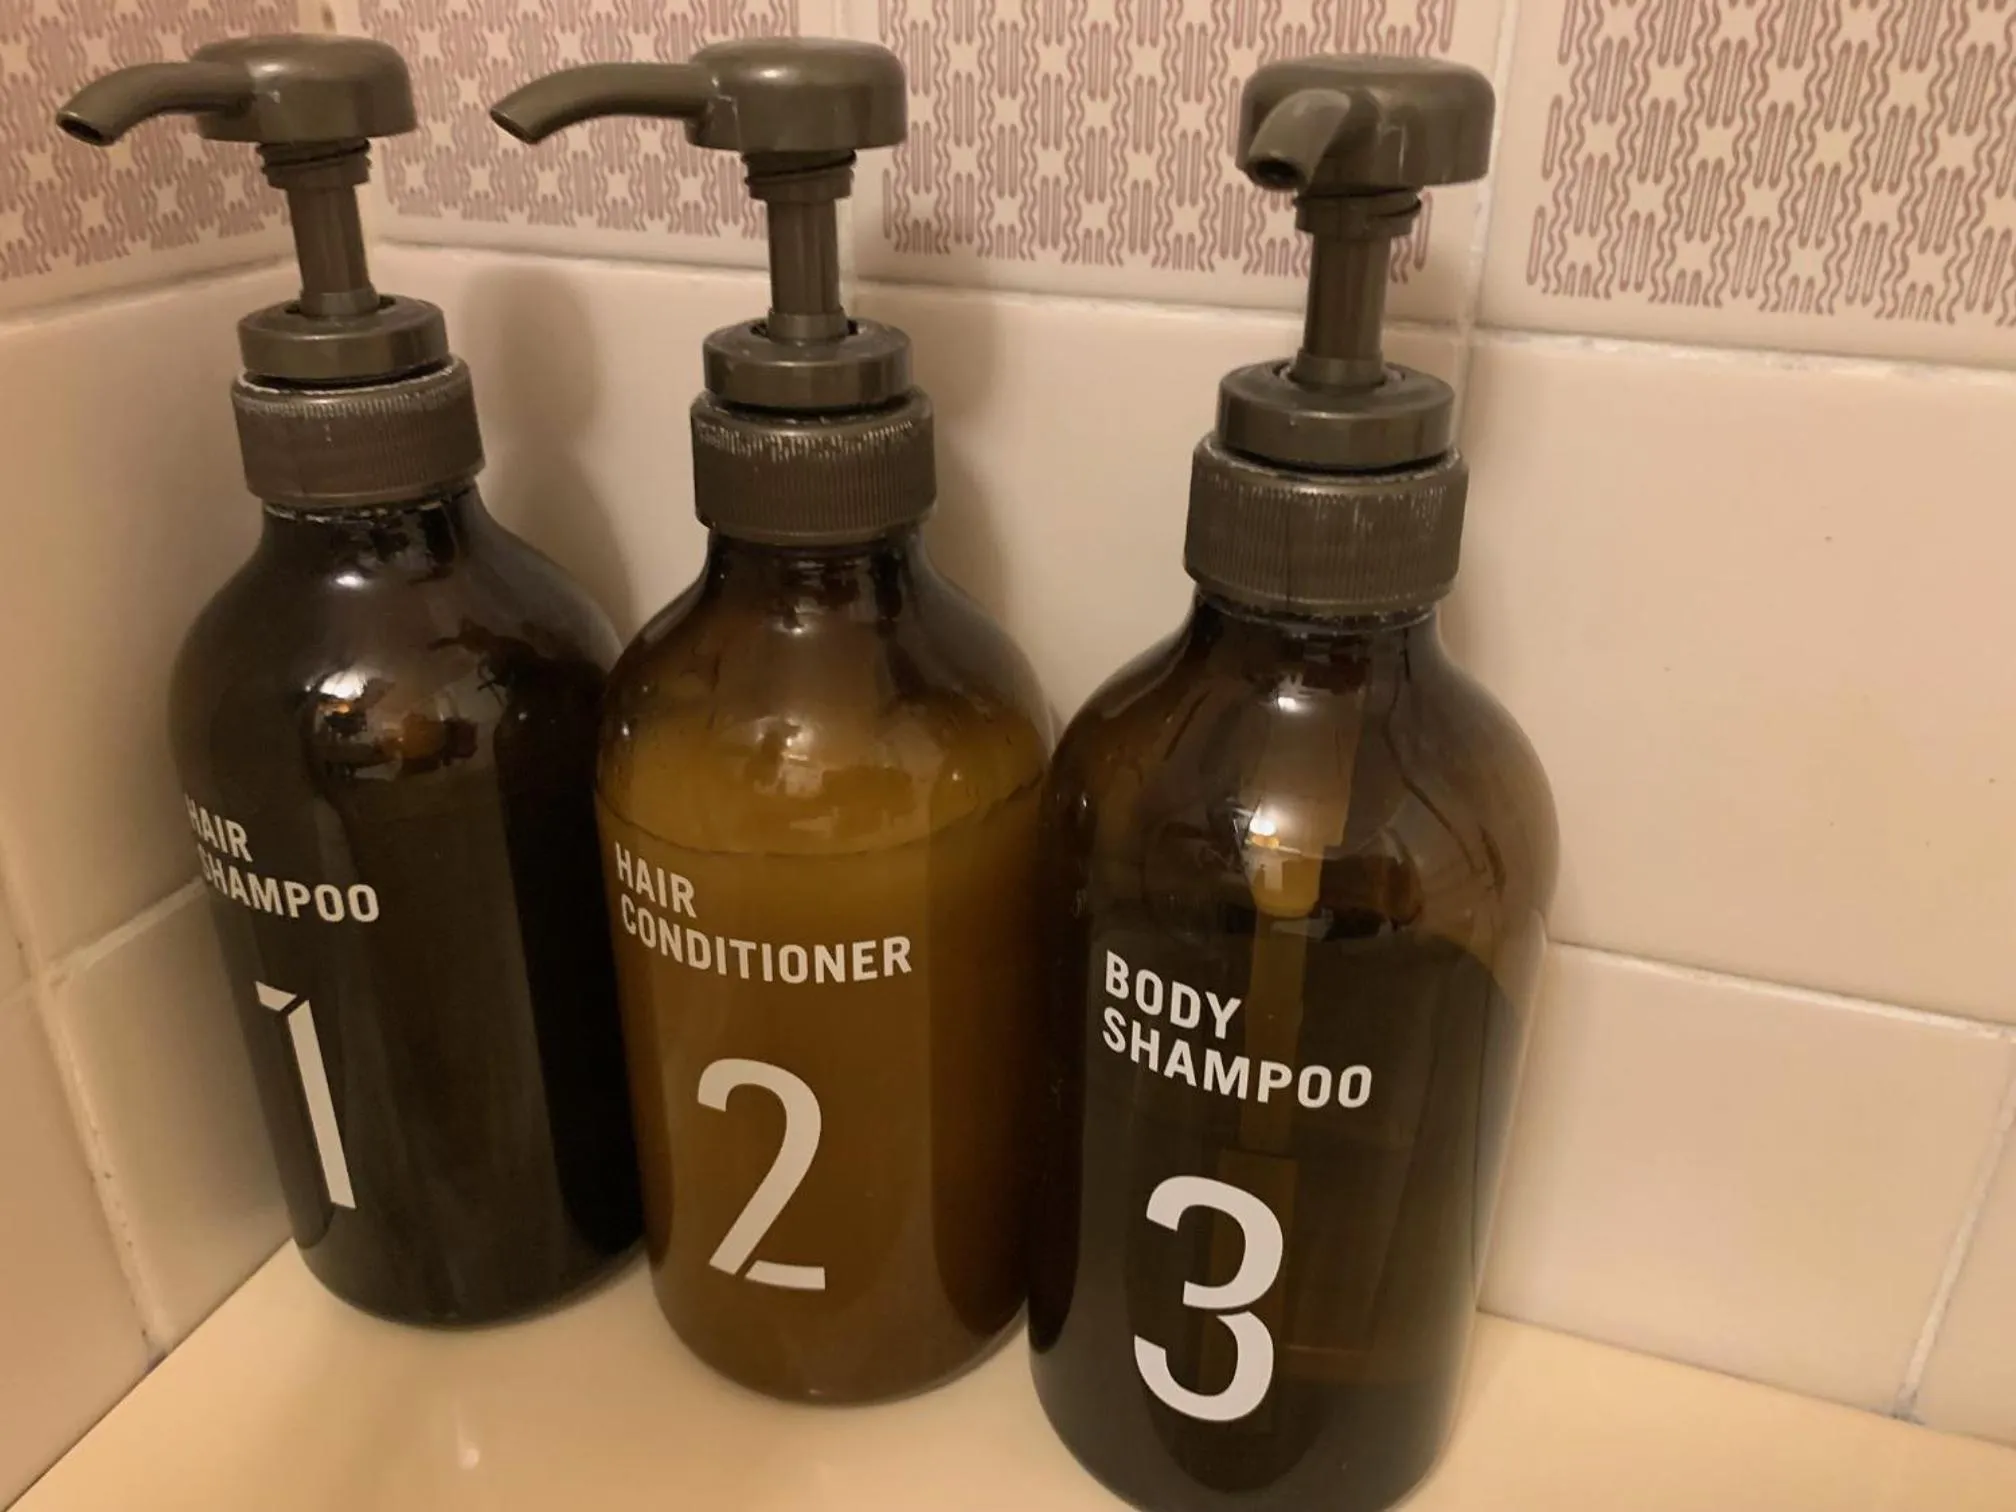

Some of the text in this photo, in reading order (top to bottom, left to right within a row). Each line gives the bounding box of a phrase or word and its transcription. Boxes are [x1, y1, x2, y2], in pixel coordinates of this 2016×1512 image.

[184, 793, 253, 862] HAIR
[198, 844, 380, 922] SHAMPOO
[614, 842, 697, 918] HAIR
[620, 893, 912, 984] CONDITIONER
[1105, 950, 1241, 1040] BODY
[256, 981, 356, 1210] 1
[1102, 1007, 1373, 1109] SHAMPOO
[697, 1058, 827, 1291] 2
[1133, 1175, 1285, 1423] 3
